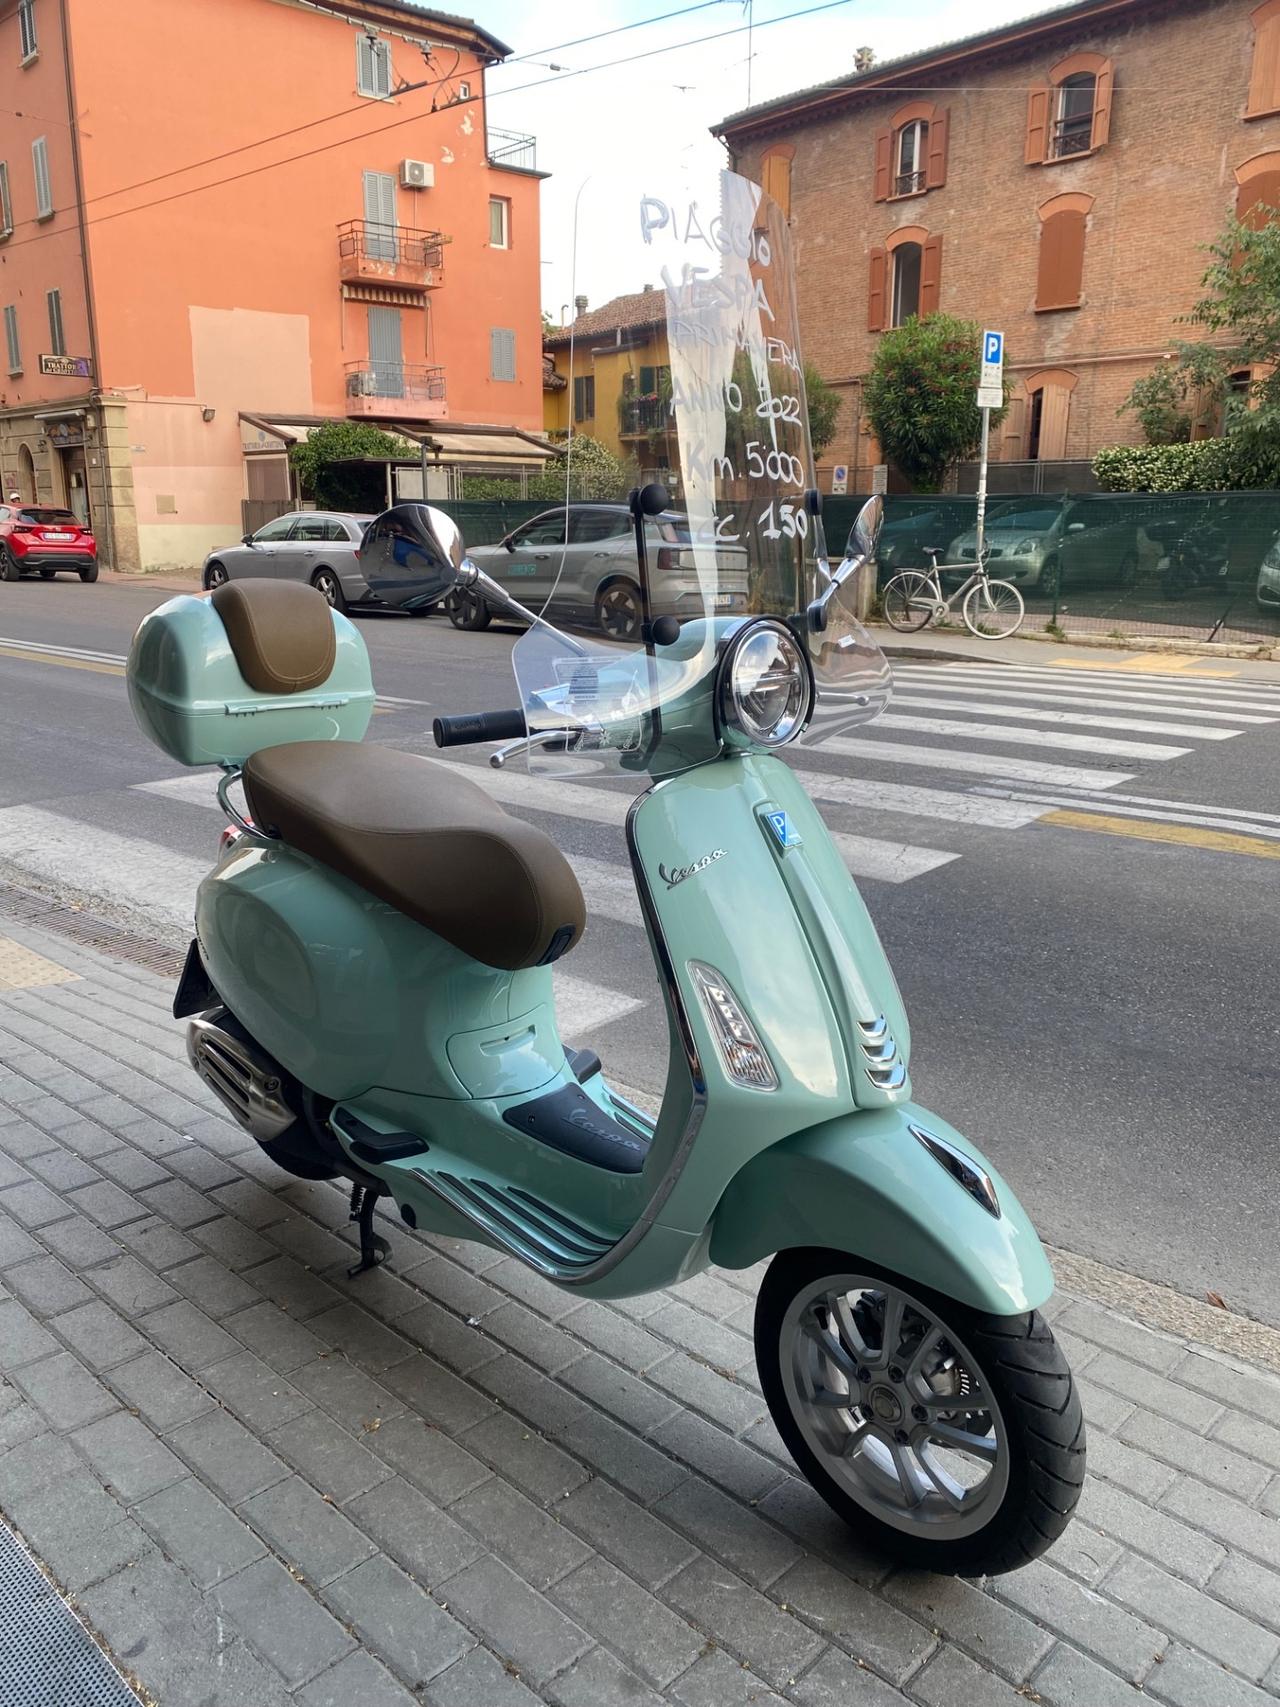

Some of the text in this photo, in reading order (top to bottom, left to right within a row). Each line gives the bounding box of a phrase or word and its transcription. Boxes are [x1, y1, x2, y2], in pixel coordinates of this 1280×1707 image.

[640, 196, 771, 267] PIAGGIO
[660, 262, 776, 322] VESPA
[987, 337, 999, 360] P
[669, 376, 742, 416] ANNO
[757, 500, 809, 541] 150
[658, 848, 729, 890] Vespa
[561, 1108, 641, 1152] Vespa
